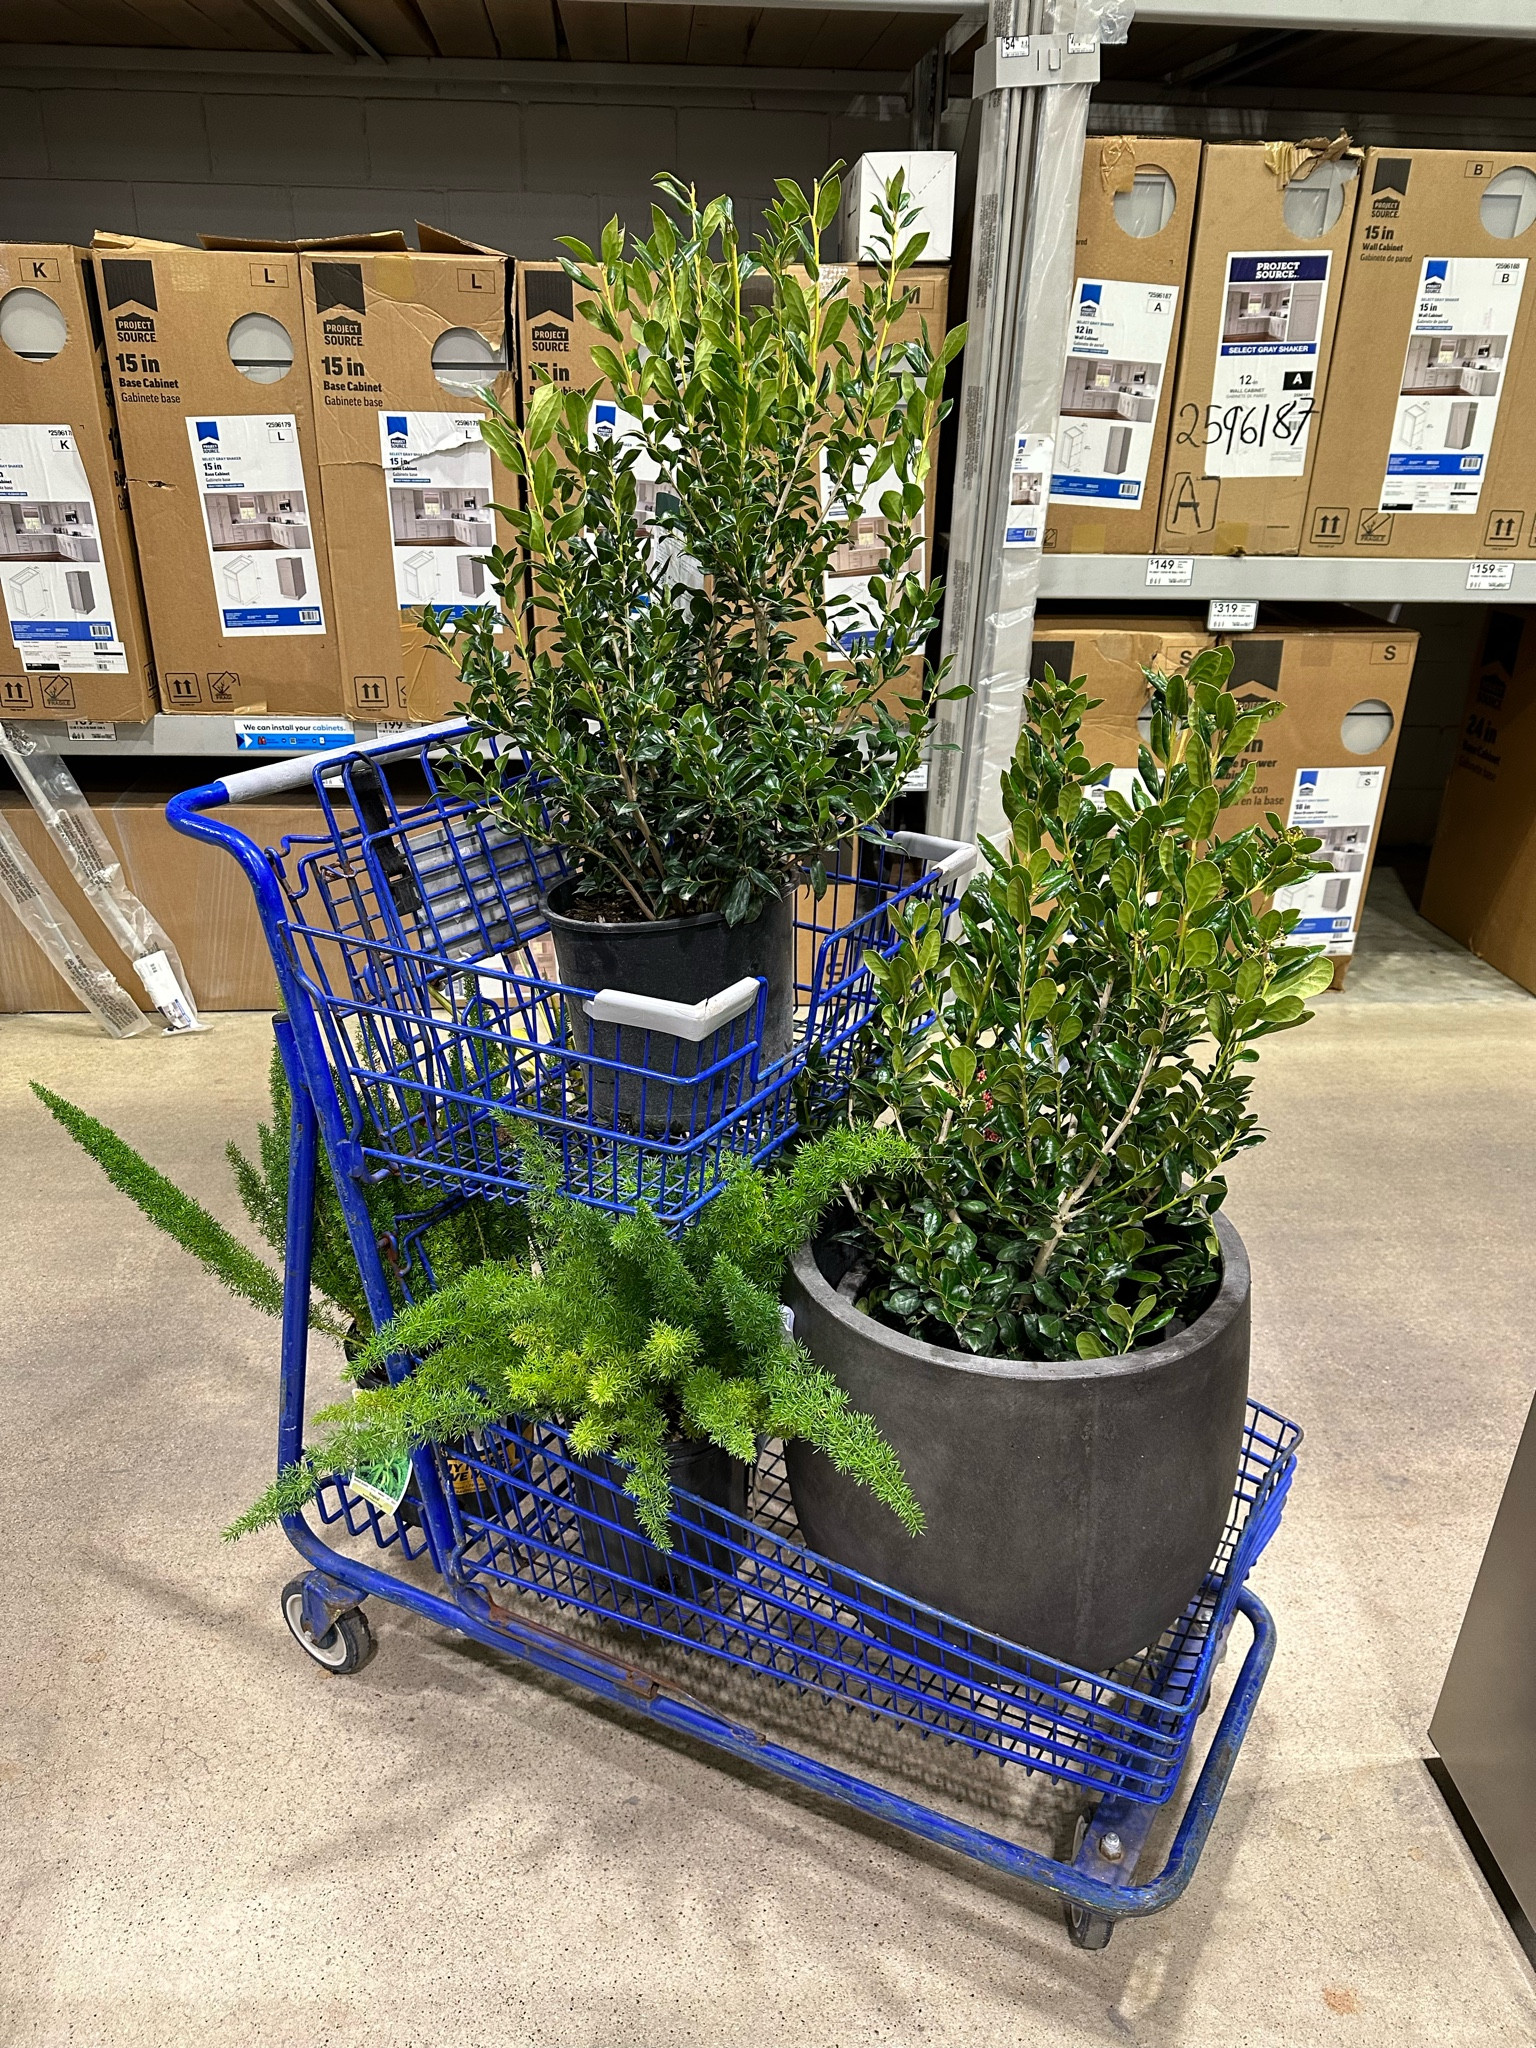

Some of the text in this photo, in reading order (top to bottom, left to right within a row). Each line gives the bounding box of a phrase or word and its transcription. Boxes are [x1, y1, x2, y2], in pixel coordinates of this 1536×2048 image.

[1474, 164, 1484, 175] B
[1365, 226, 1394, 240] 15 in
[1362, 243, 1404, 252] Wall Cabinet
[1360, 254, 1386, 262] Gabinete
[1395, 255, 1412, 263] pared
[33, 262, 48, 278] K
[1256, 262, 1300, 271] PROJECT
[264, 268, 275, 284] L
[1502, 273, 1510, 282] B
[472, 274, 482, 289] L
[902, 285, 920, 304] M
[1154, 302, 1162, 312] A
[1420, 303, 1438, 312] 15 in
[118, 320, 152, 330] PROJECT
[326, 324, 359, 334] PROJECT
[1076, 326, 1093, 334] 12 in
[534, 330, 566, 339] PROJECT
[1228, 344, 1308, 354] SELECT GRAY SHAKER
[116, 353, 160, 372] 15 in
[321, 356, 364, 376] 15 in
[553, 362, 570, 382] in
[119, 378, 179, 388] Base Cabinet
[1292, 372, 1303, 384] A
[324, 380, 382, 392] Base Cabinet
[121, 392, 181, 403] Gabinete base
[324, 396, 383, 407] Gabinete base
[1176, 397, 1320, 455] 2596187
[277, 432, 285, 441] L
[465, 430, 471, 439] L
[60, 440, 70, 450] K
[203, 462, 213, 470] 15
[390, 458, 399, 466] 15
[1172, 475, 1201, 528] A
[1150, 560, 1175, 569] $149
[1472, 563, 1496, 574] $159
[1214, 603, 1238, 613] $319
[1180, 650, 1192, 665] S
[1384, 645, 1396, 661] S
[1466, 714, 1498, 744] 24 in
[1364, 778, 1371, 786] S
[1252, 786, 1268, 794] con
[1254, 796, 1263, 805] la
[1265, 796, 1284, 805] base
